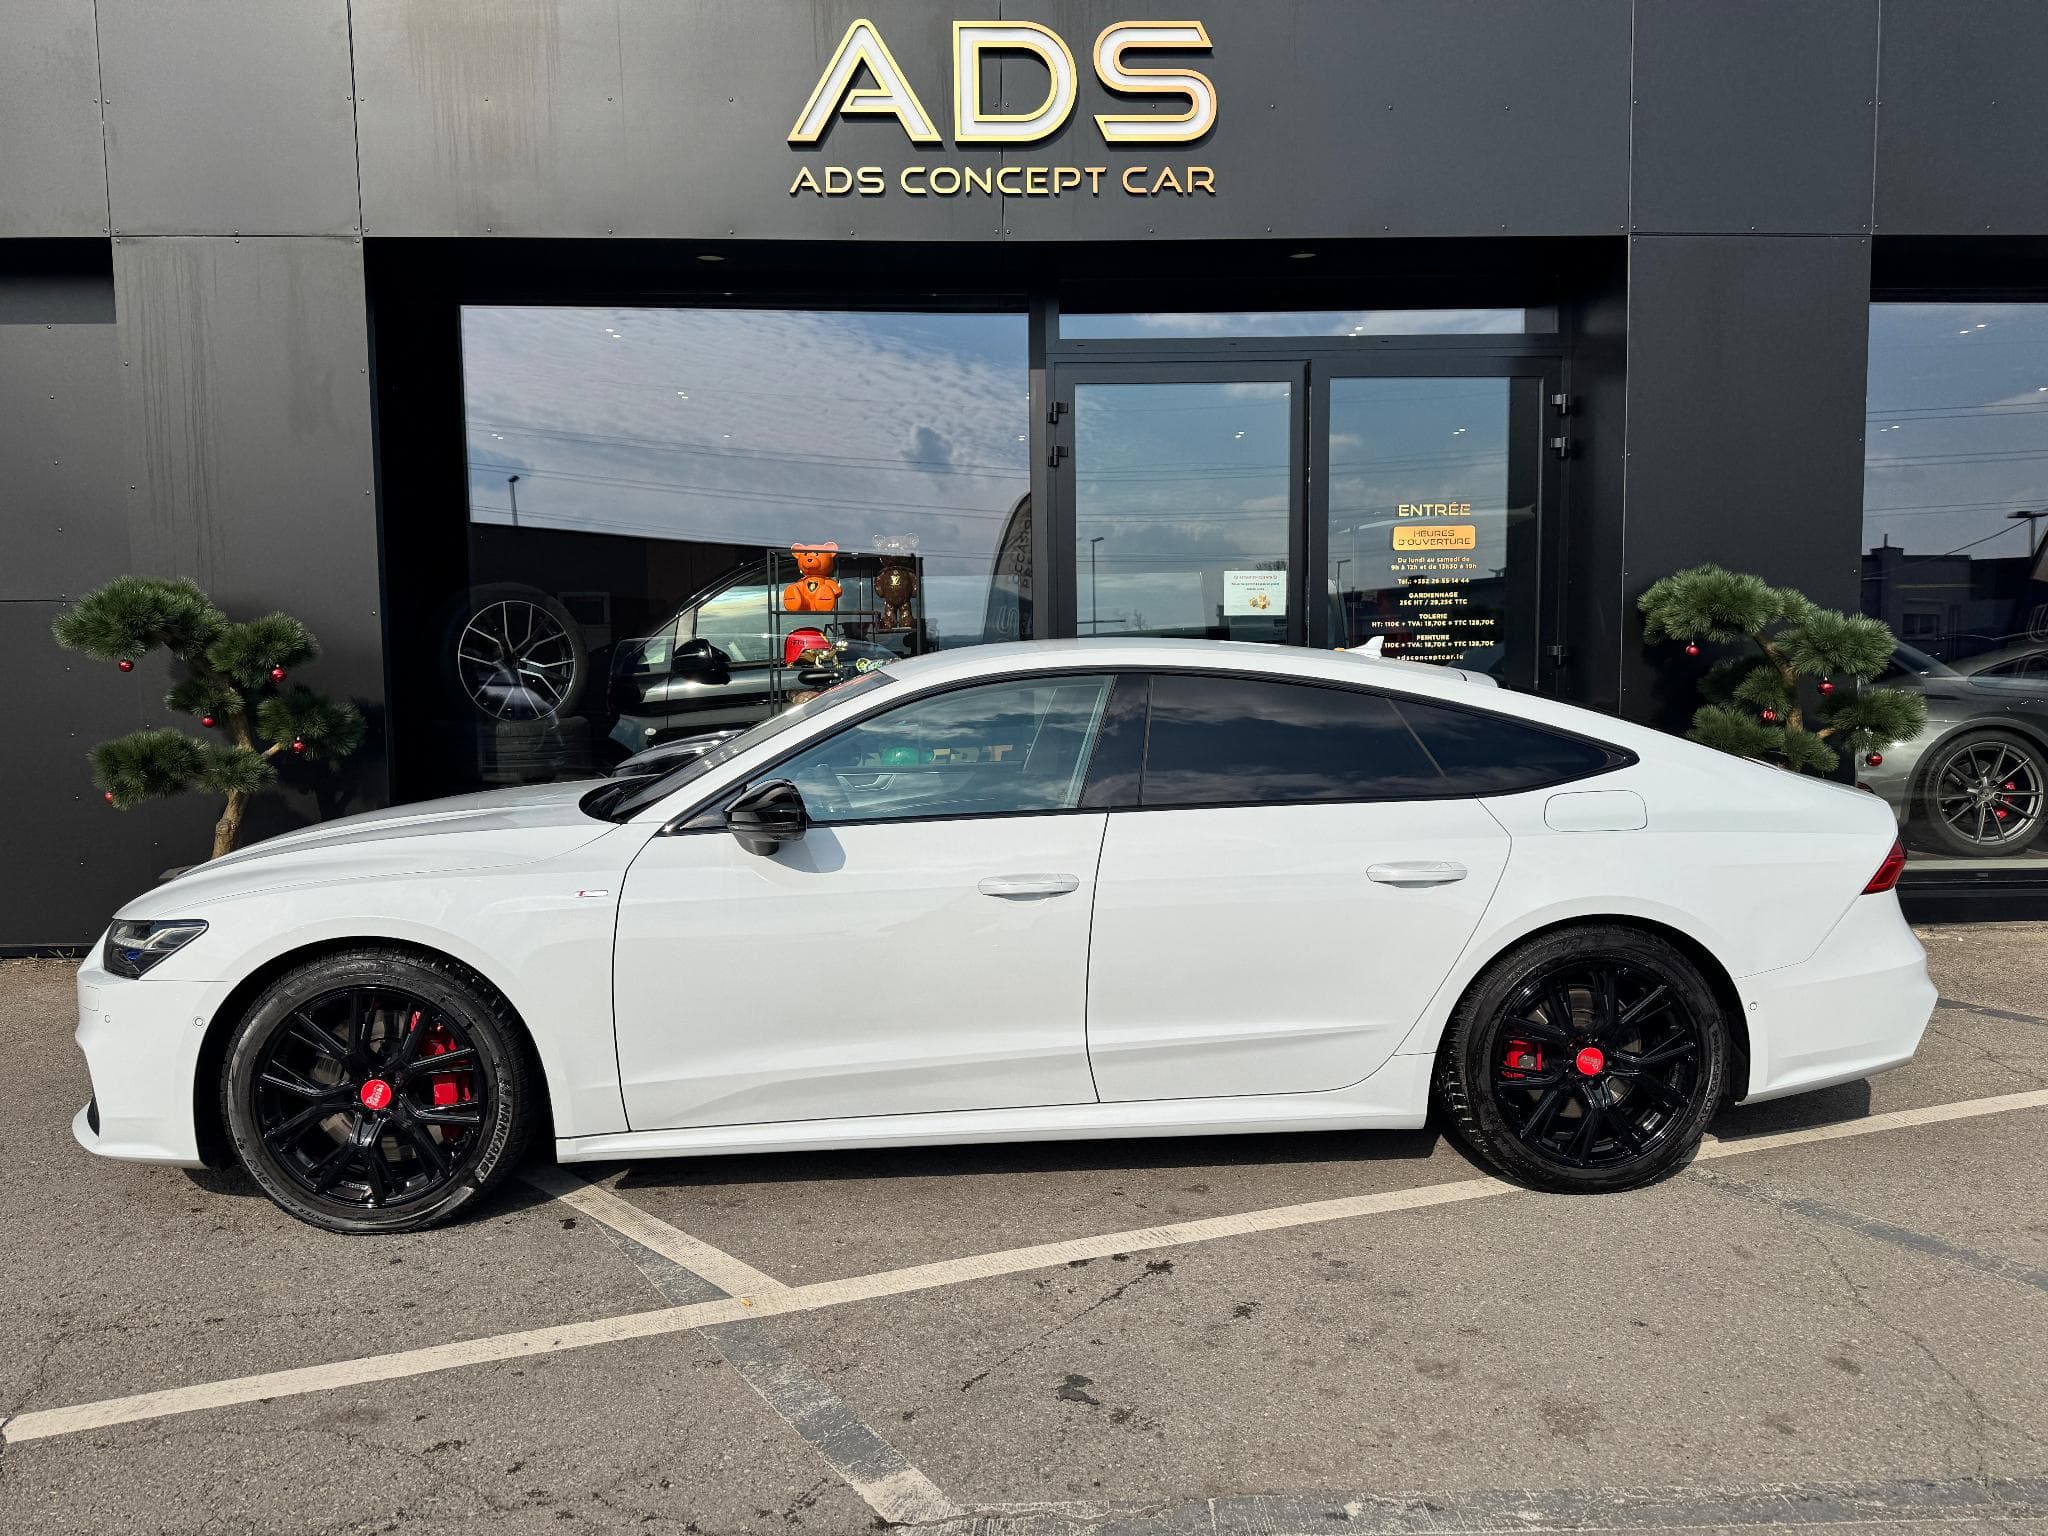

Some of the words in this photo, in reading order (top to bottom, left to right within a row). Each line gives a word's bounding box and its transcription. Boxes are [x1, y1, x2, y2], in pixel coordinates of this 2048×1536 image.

[787, 19, 1217, 142] ADS
[790, 166, 884, 194] ADS
[901, 166, 1106, 194] CONCEPT
[1122, 166, 1216, 194] CAR
[1398, 502, 1471, 516] ENTRÉE
[1398, 538, 1470, 546] D'OUVERTURE
[1414, 530, 1454, 538] HEURES
[480, 1102, 512, 1174] NANKANG
